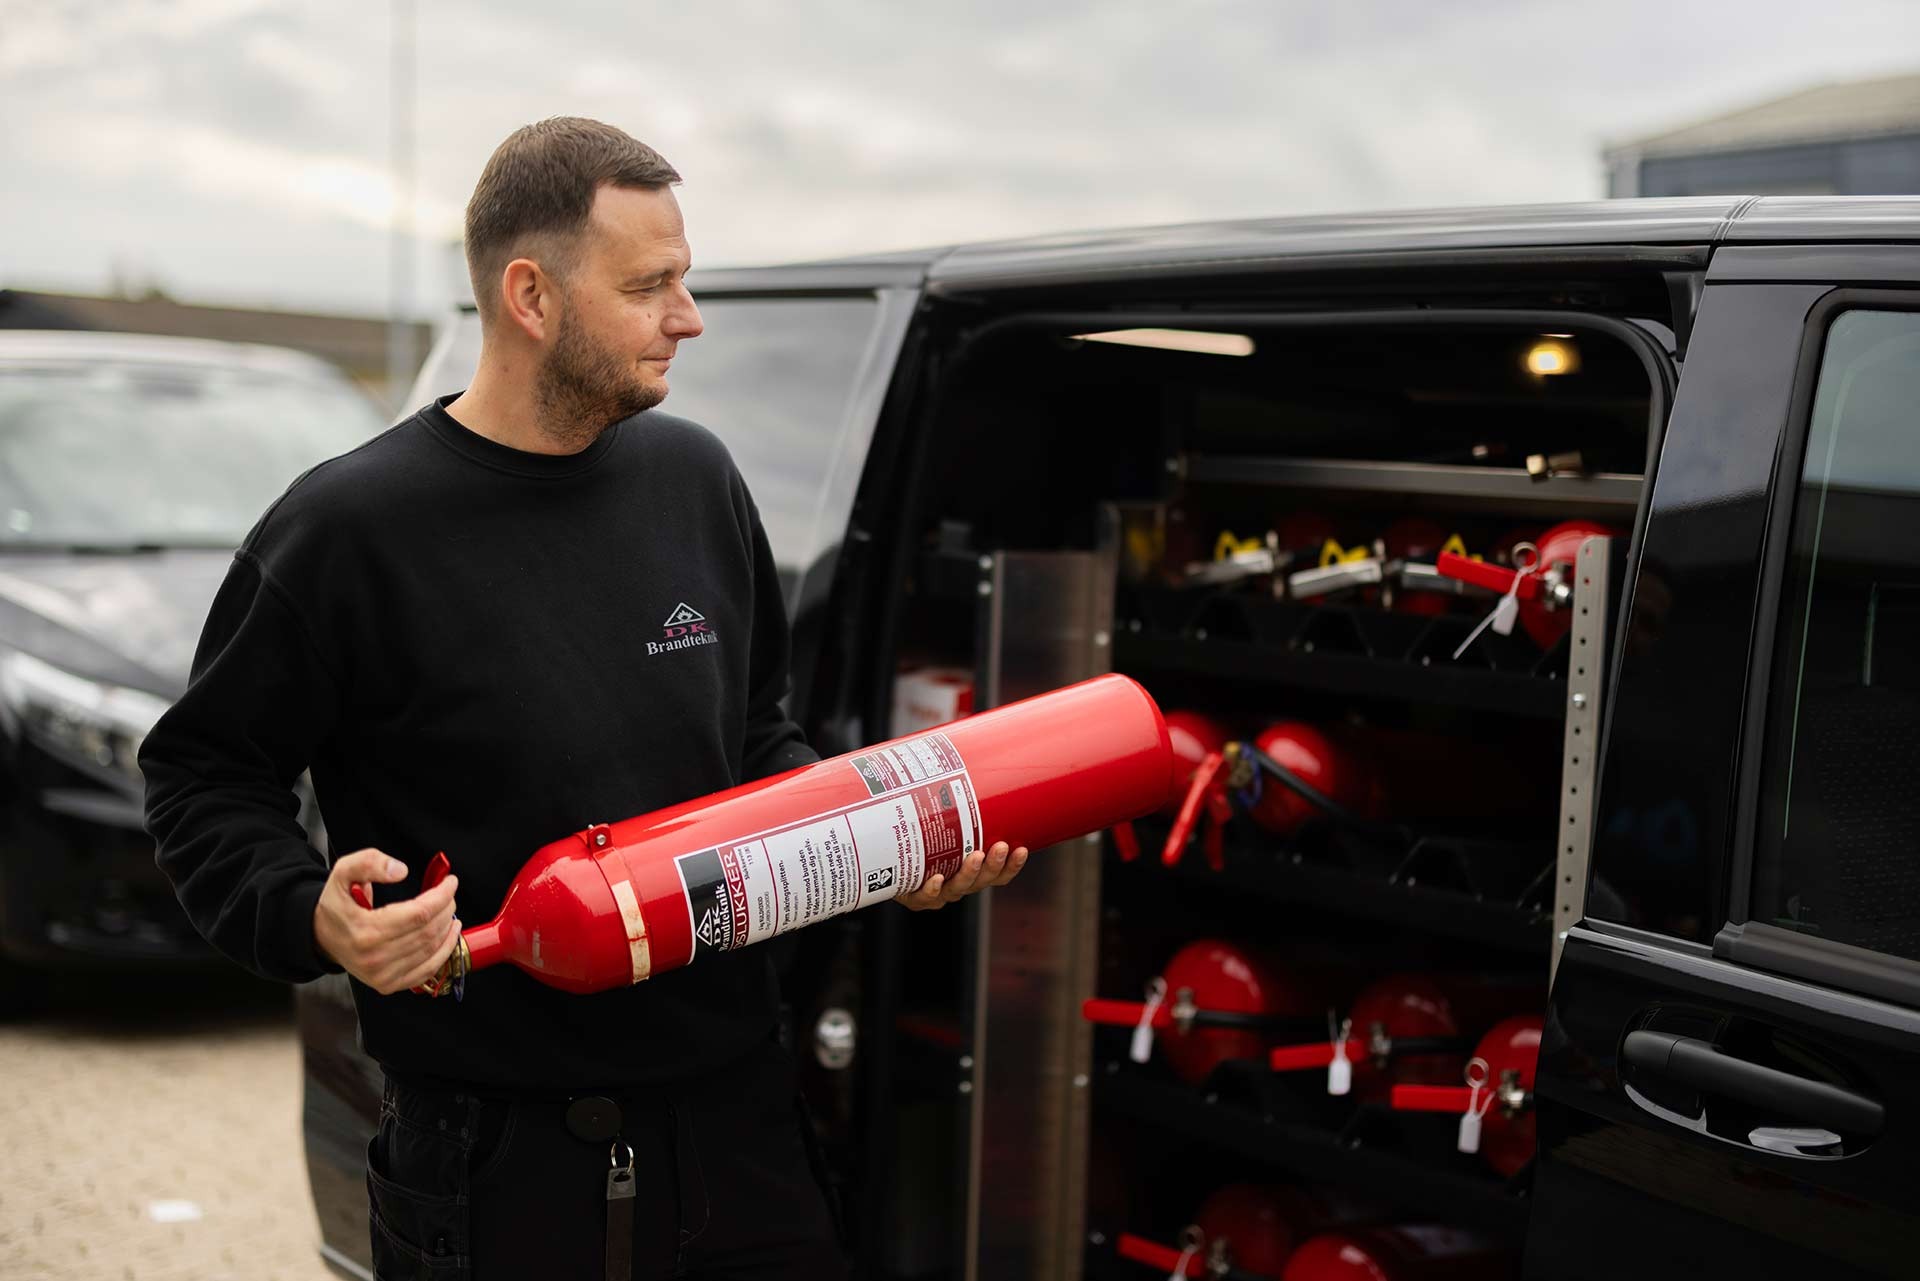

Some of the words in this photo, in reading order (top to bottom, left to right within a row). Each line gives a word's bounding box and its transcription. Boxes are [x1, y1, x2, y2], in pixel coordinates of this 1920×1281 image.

[664, 621, 712, 638] DK
[646, 631, 718, 656] Brandteknik
[896, 805, 904, 820] Volt
[829, 828, 838, 845] side.
[892, 825, 902, 841] mod
[805, 838, 813, 855] selv.
[824, 840, 831, 851] og
[799, 850, 809, 878] bunden
[826, 851, 835, 867] ned,
[836, 854, 844, 869] side
[779, 860, 791, 912] sikringssplitten.
[803, 878, 811, 893] mod
[811, 868, 820, 897] nærmest
[868, 873, 878, 882] B
[712, 904, 722, 944] DK
[716, 884, 730, 951] Brandteknik
